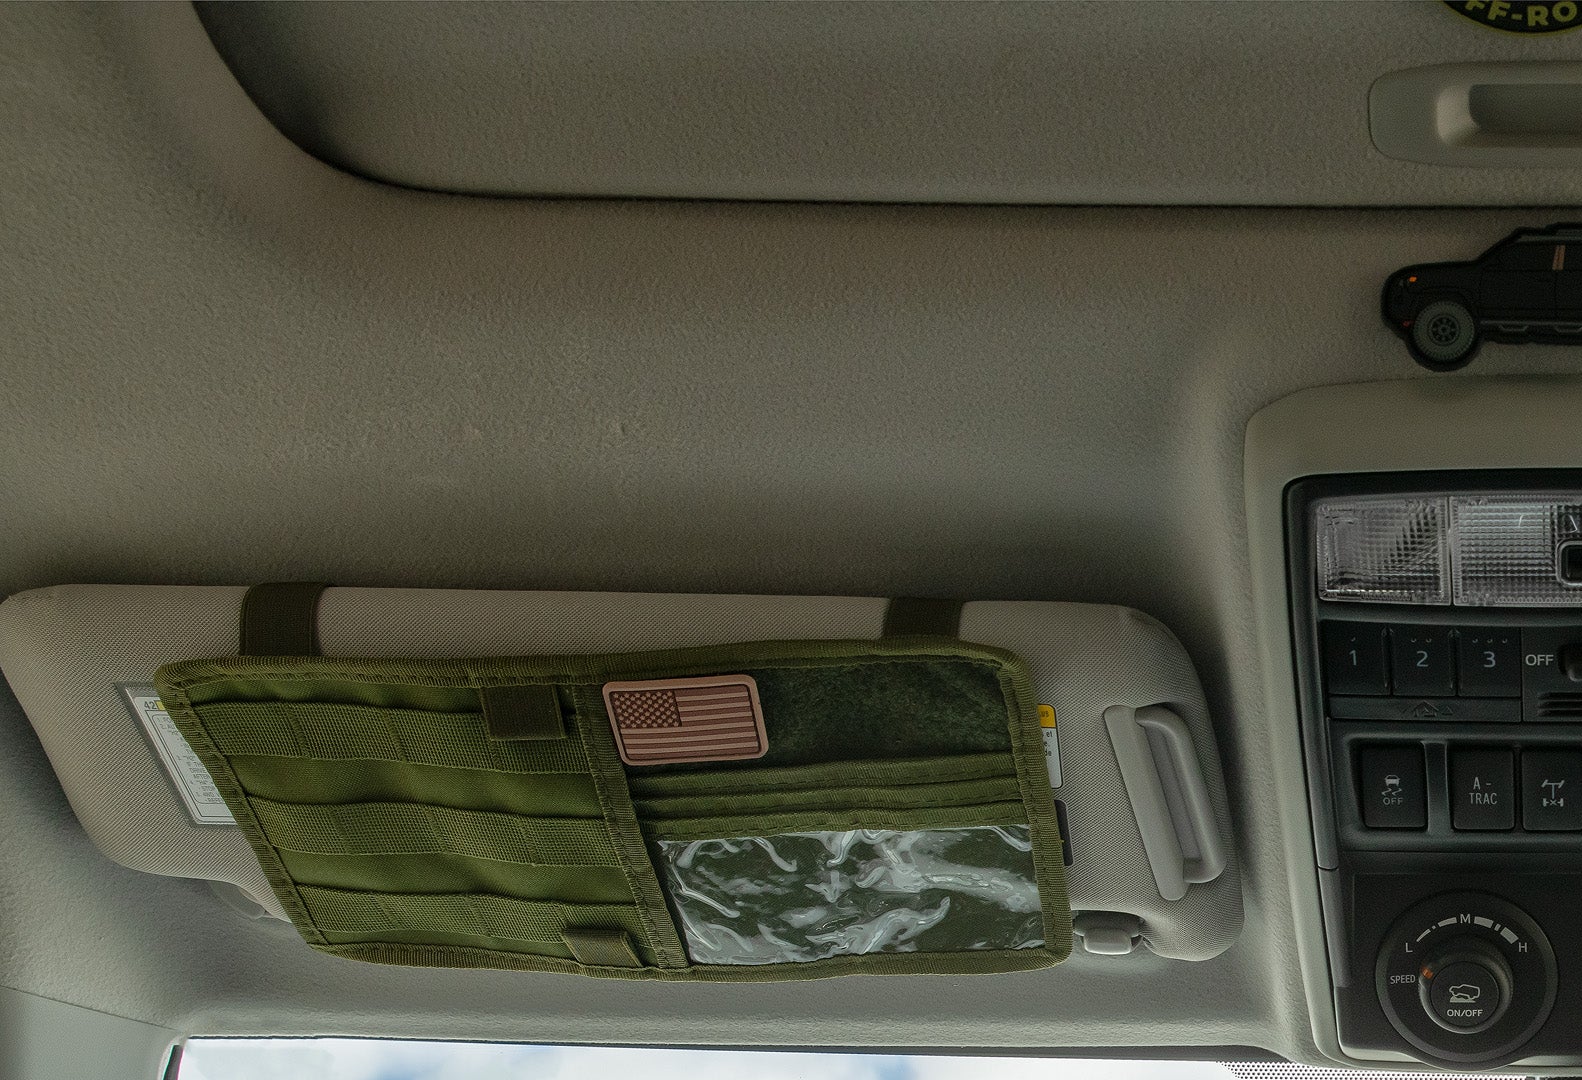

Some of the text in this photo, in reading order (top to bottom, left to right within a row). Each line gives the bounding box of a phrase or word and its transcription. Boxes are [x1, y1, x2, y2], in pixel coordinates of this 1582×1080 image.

[1349, 649, 1358, 666] 1
[1416, 650, 1429, 668] 2
[1483, 651, 1497, 668] 3
[1525, 653, 1555, 667] OFF
[1382, 797, 1403, 806] OFF
[1469, 792, 1498, 805] TRAC
[1460, 913, 1471, 924] M
[1405, 942, 1413, 953] L
[1518, 942, 1528, 953] H
[1390, 974, 1416, 985] SPEED
[1446, 1009, 1484, 1017] ON/OFF
